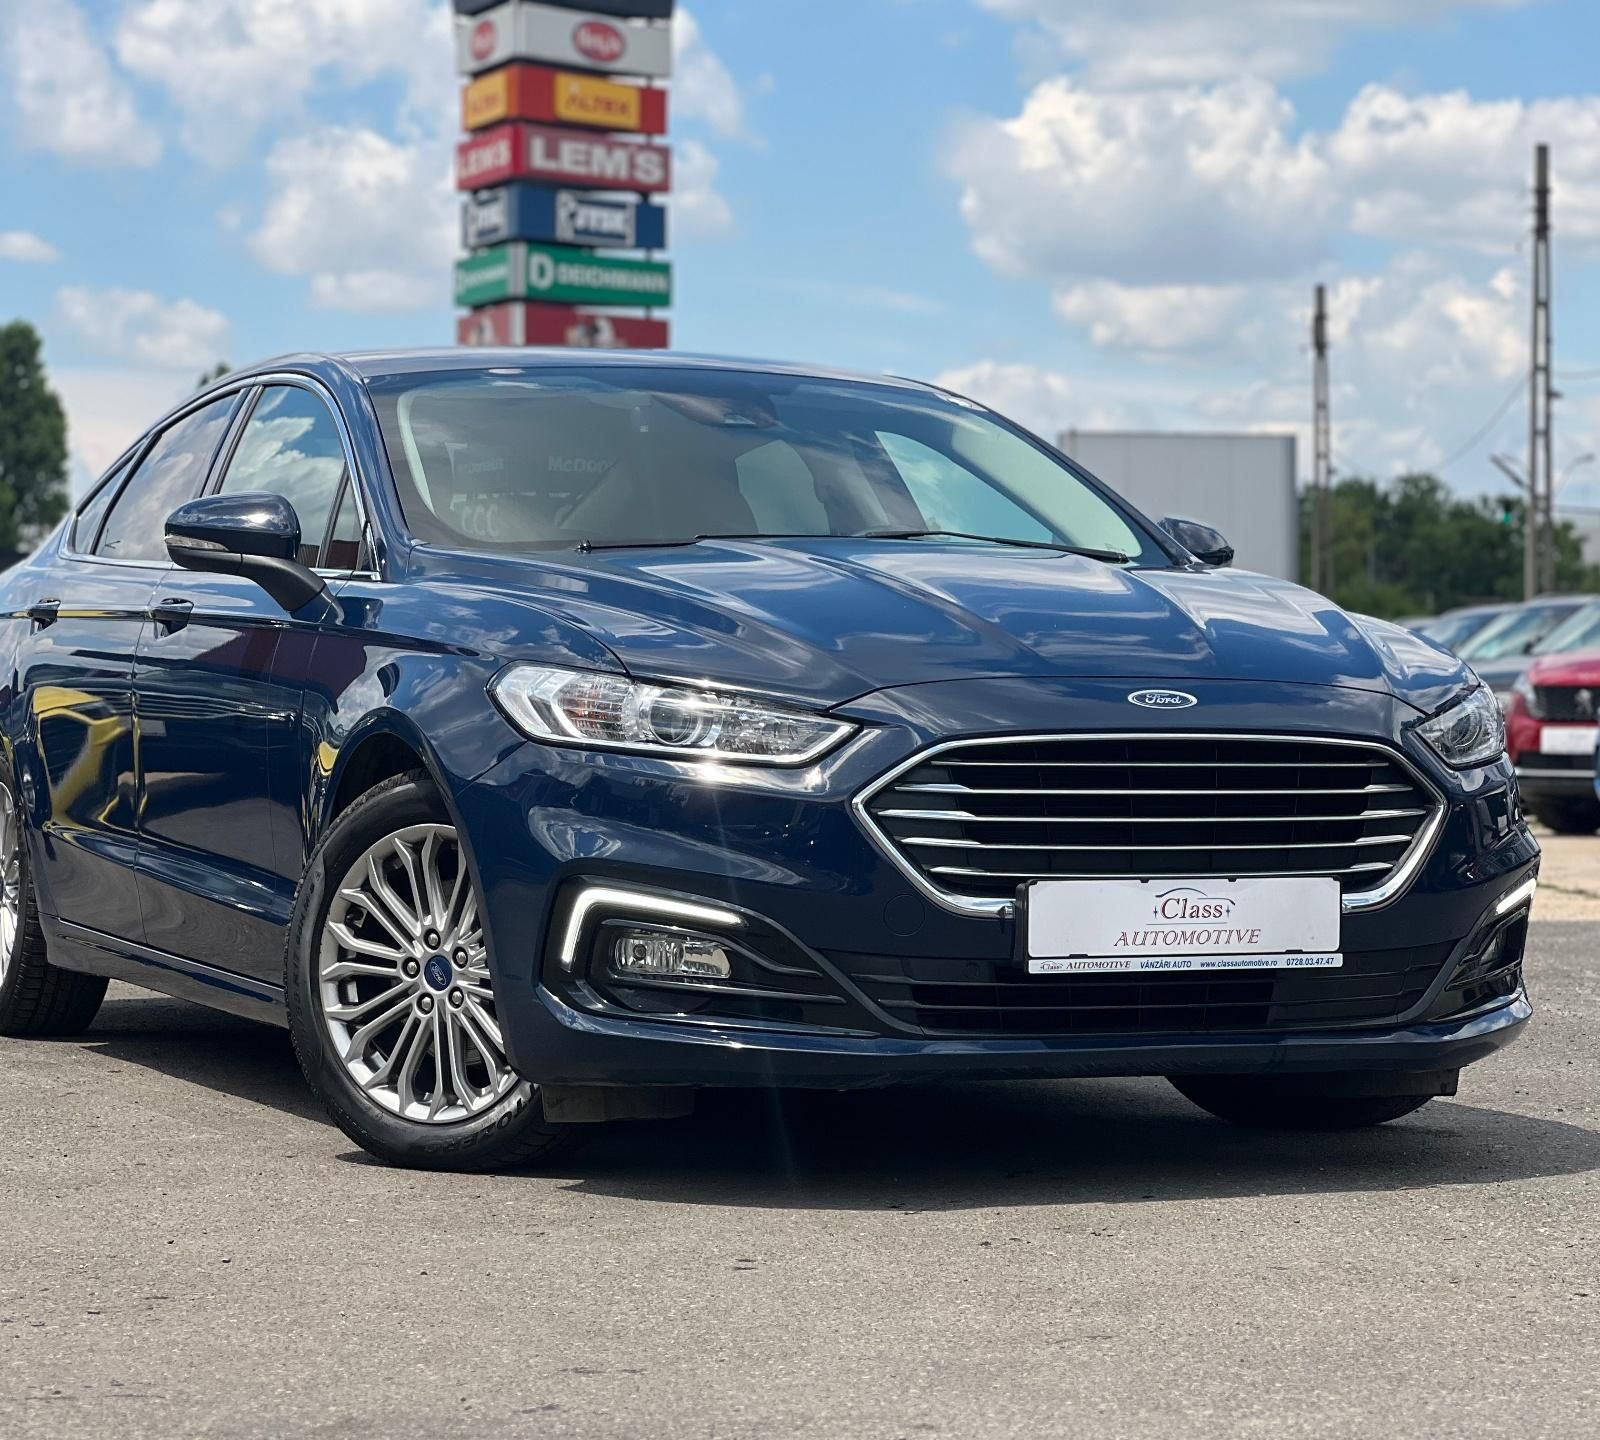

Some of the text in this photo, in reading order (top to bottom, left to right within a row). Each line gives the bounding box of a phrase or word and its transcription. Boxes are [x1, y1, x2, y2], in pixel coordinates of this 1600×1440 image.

[1145, 693, 1182, 704] Ford
[1160, 898, 1223, 920] Class
[1113, 929, 1262, 947] AUTOMOTIVE
[1066, 960, 1131, 970] AUTOMOTIVE
[1172, 959, 1192, 968] AUTO
[1200, 958, 1278, 968] www.classautomotive.ro
[1286, 957, 1335, 966] 0728.03.47.47
